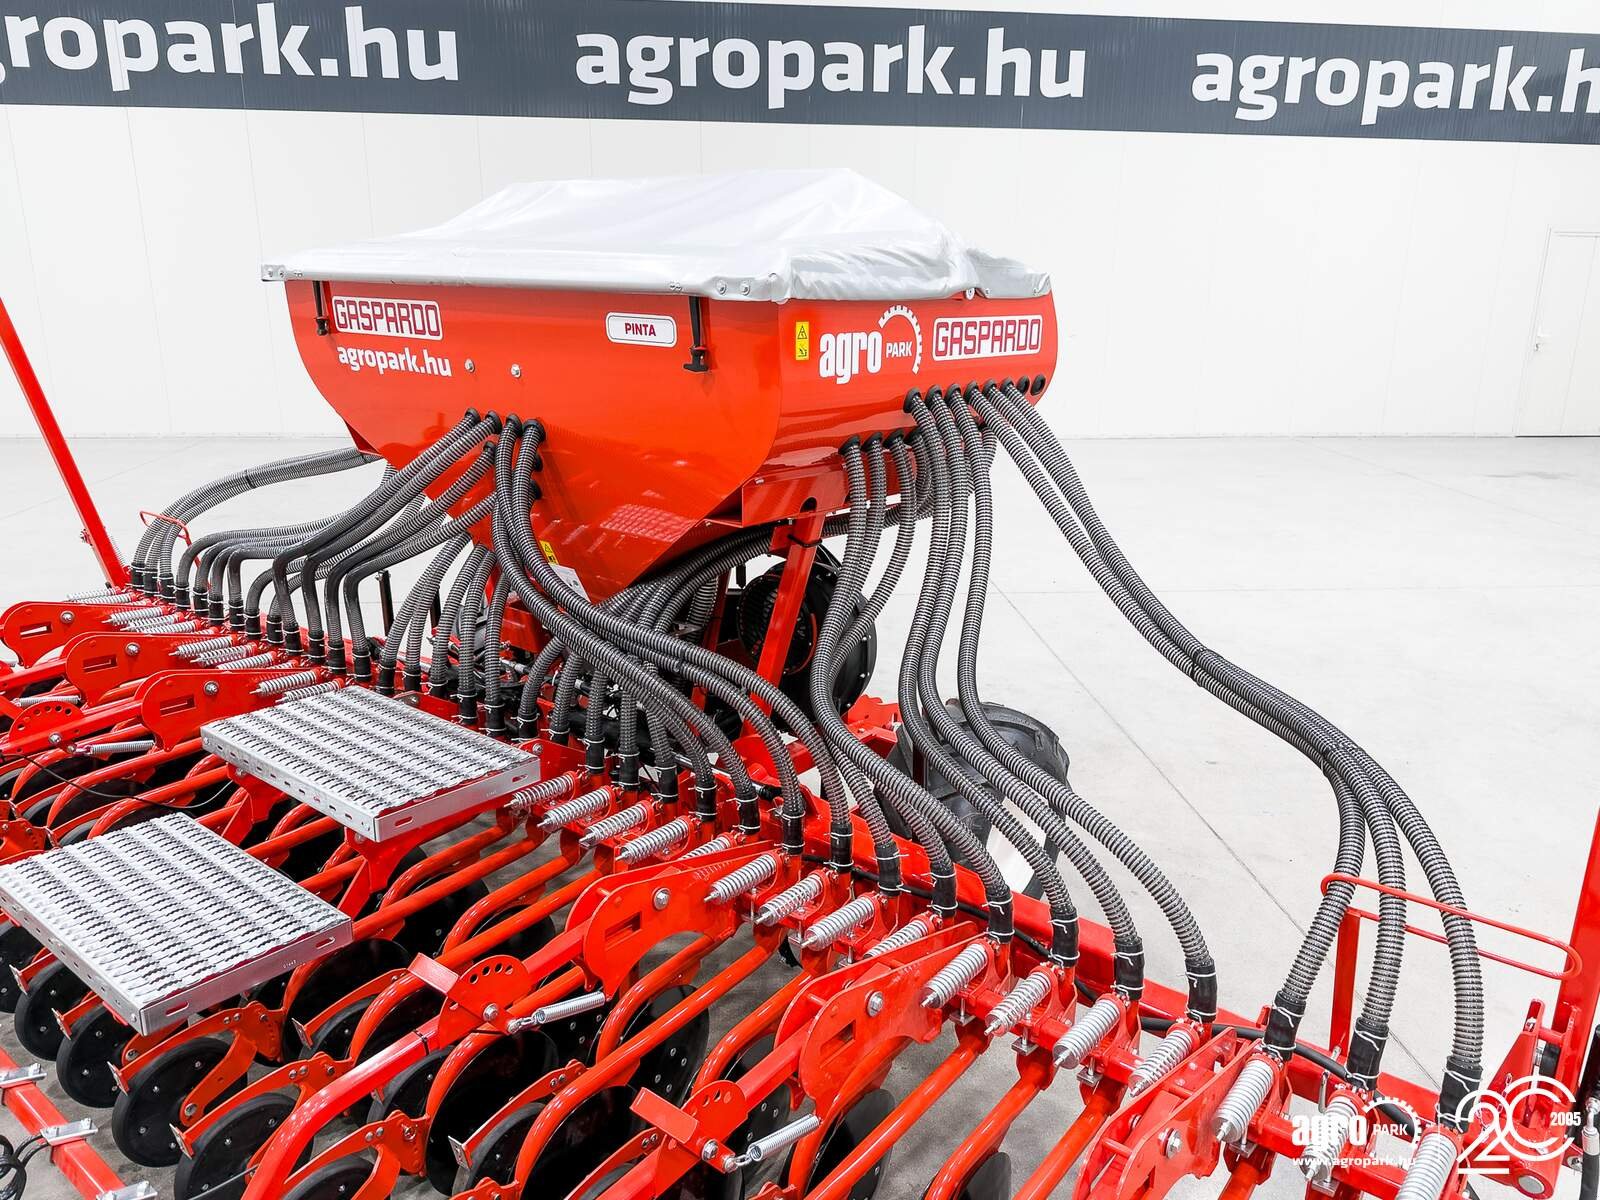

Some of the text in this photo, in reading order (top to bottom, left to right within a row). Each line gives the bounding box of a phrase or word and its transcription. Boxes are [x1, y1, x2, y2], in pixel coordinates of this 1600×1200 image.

[0, 2, 458, 92] ropark.hu
[576, 25, 1086, 110] agropark.hu
[333, 299, 441, 337] GASPARDO
[624, 322, 656, 337] PINTA
[935, 318, 1041, 357] GASPARDO
[337, 346, 452, 378] agropark.hu
[819, 331, 912, 384] agro PARK
